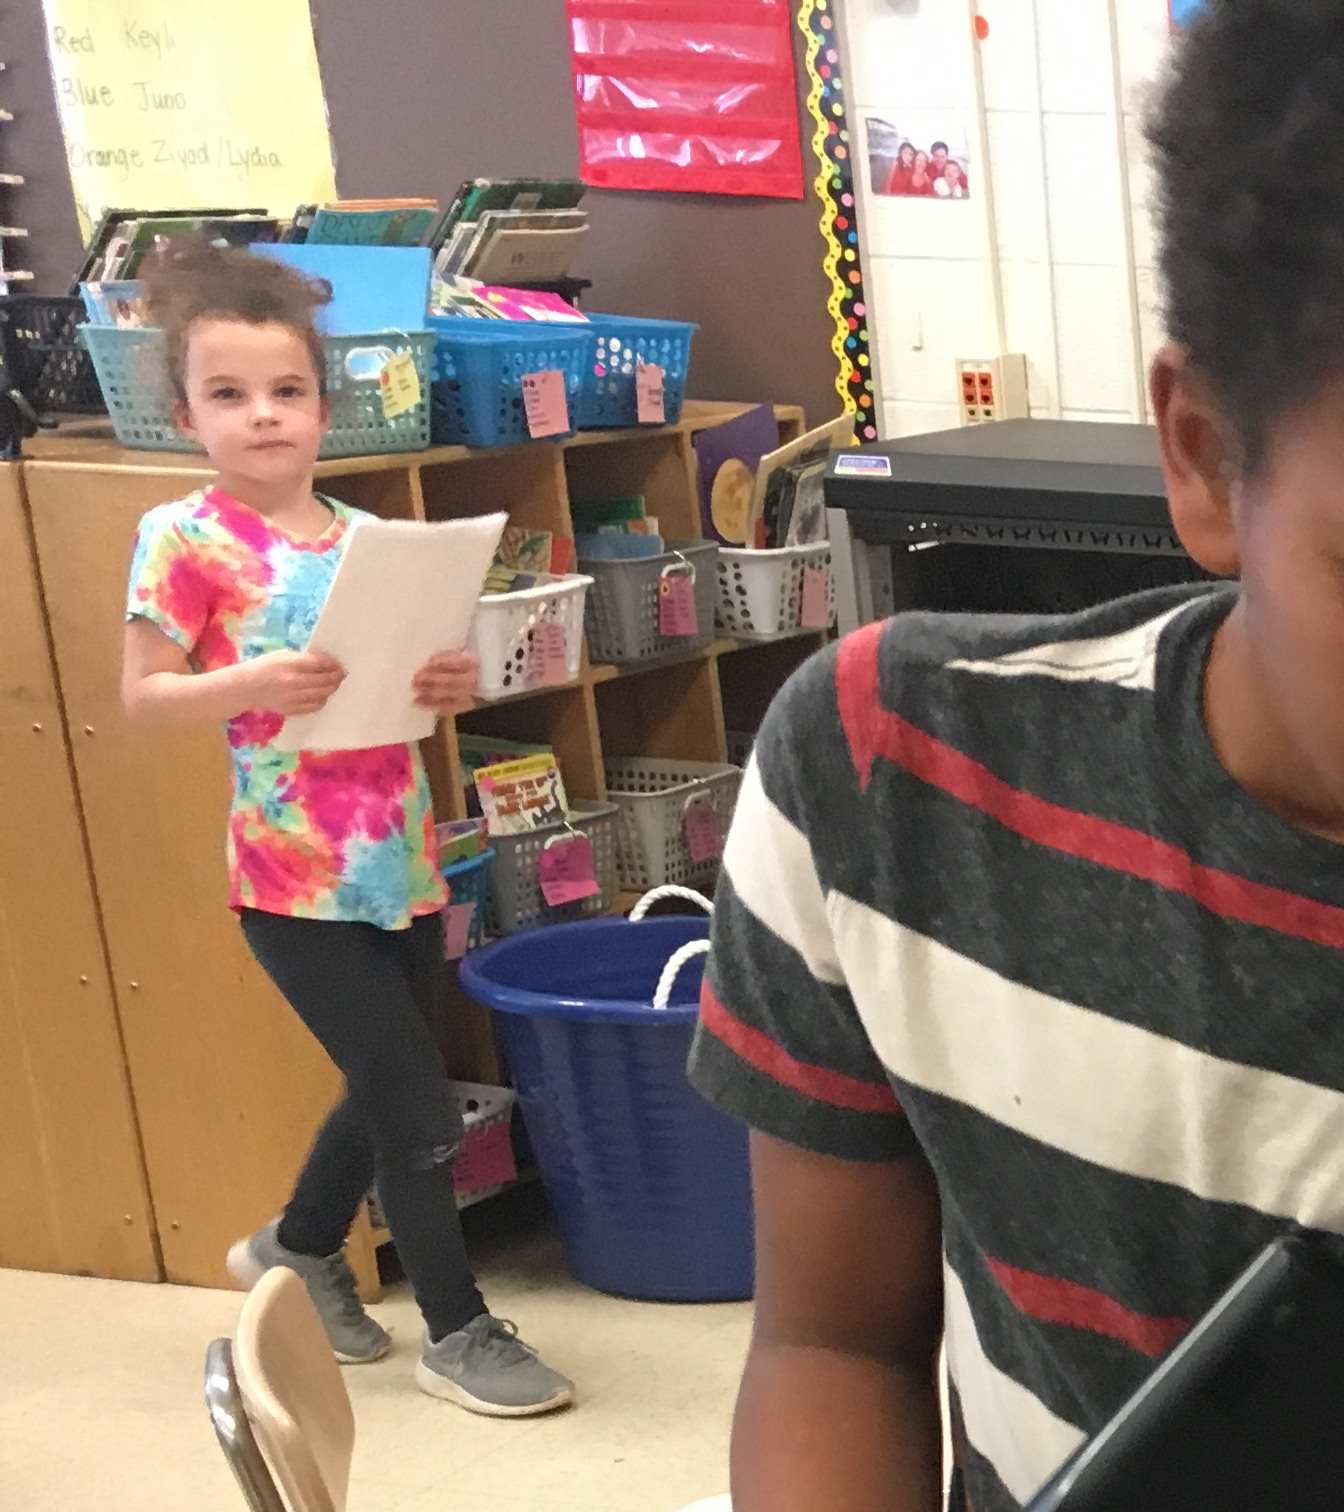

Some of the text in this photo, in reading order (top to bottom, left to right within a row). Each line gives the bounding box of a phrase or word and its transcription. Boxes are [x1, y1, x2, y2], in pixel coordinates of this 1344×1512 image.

[54, 25, 95, 53] Red
[61, 77, 115, 107] Blue
[69, 140, 144, 182] Orange
